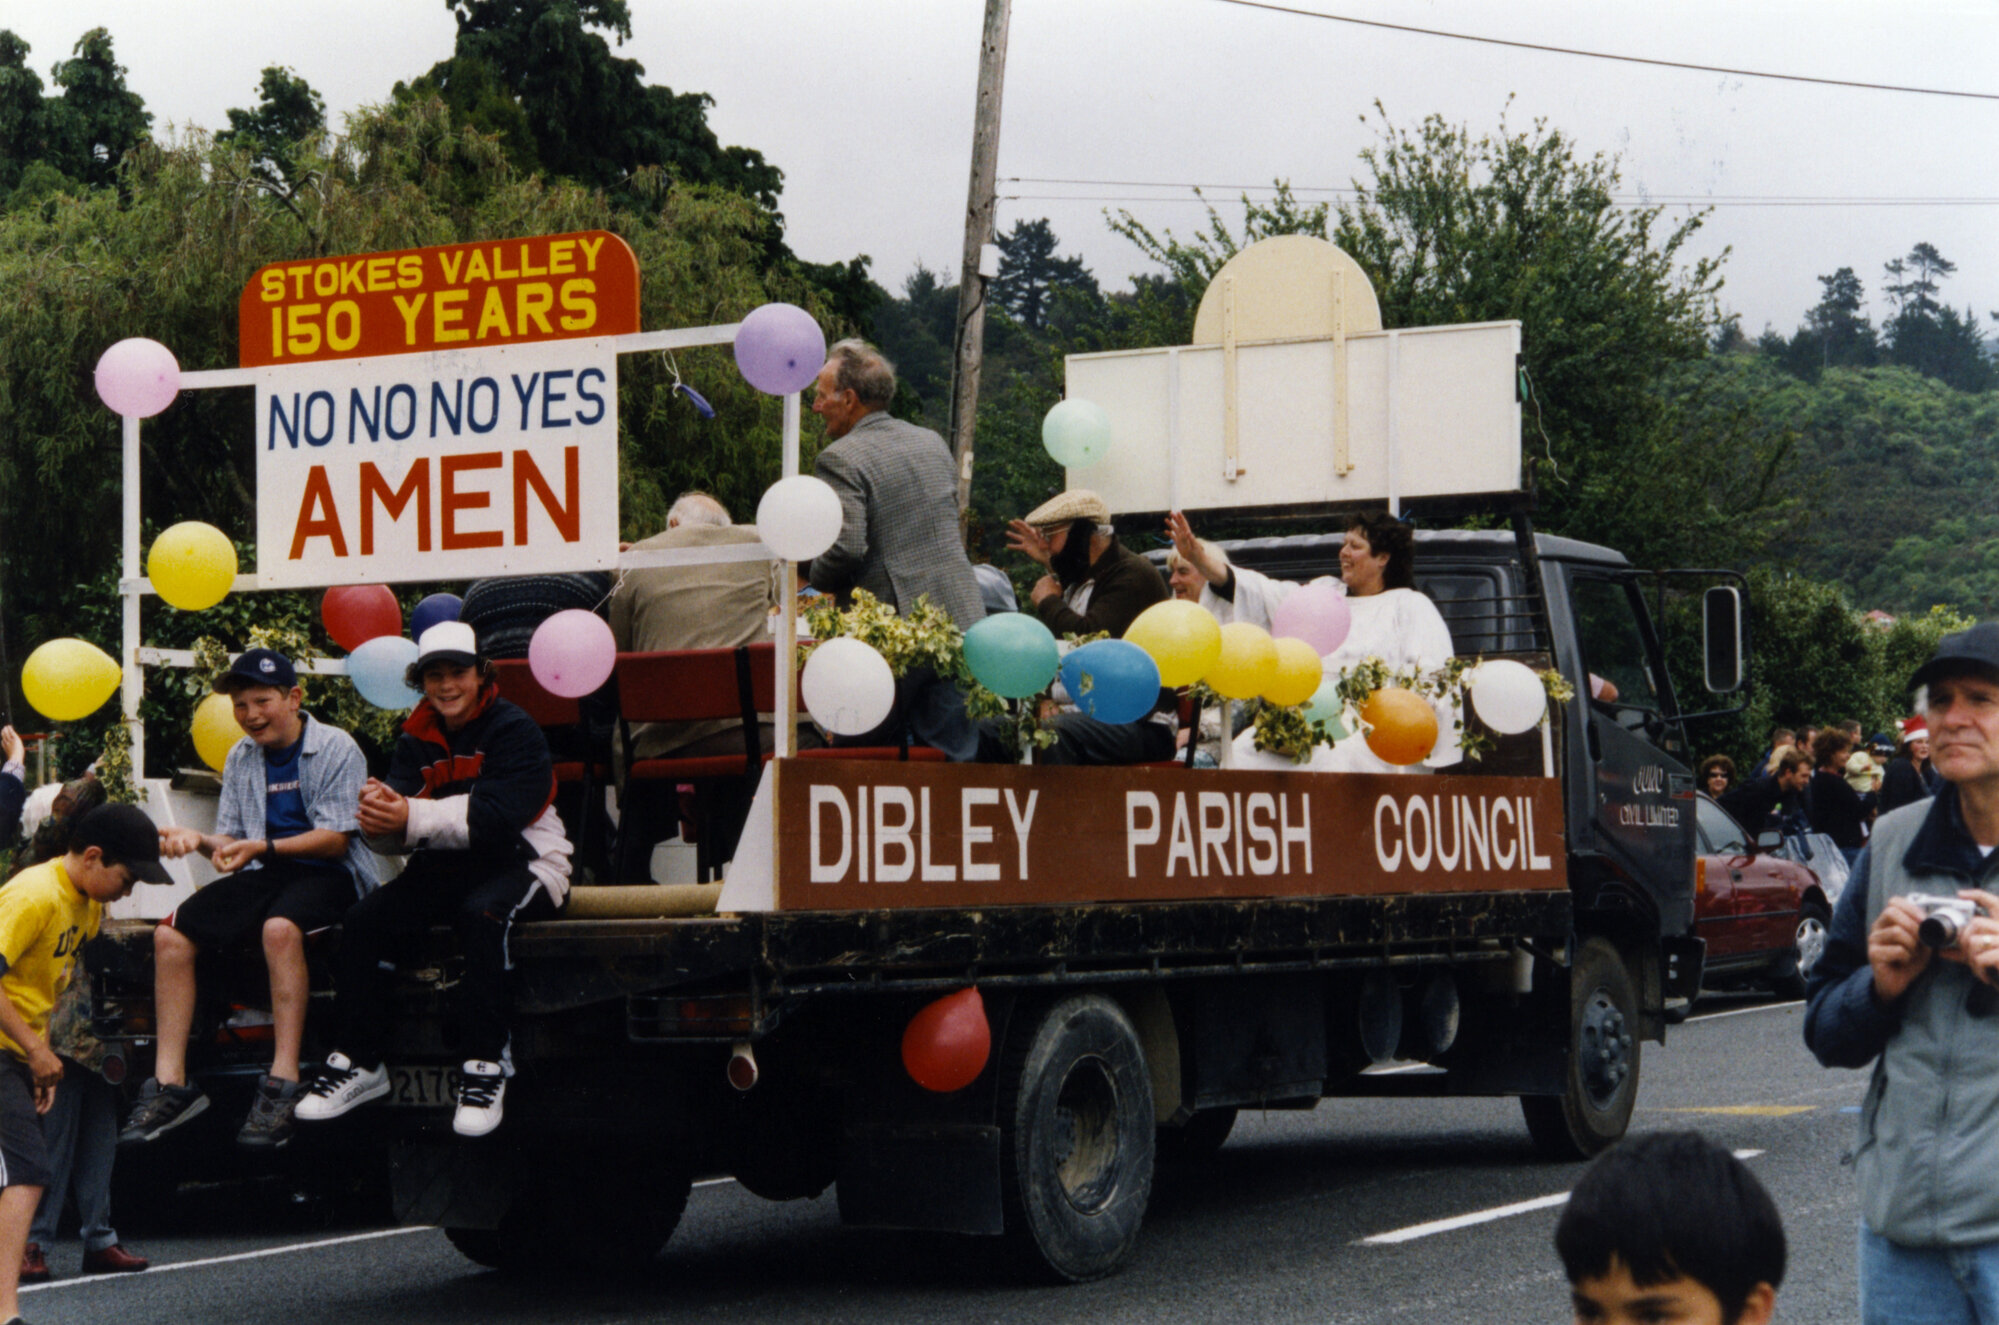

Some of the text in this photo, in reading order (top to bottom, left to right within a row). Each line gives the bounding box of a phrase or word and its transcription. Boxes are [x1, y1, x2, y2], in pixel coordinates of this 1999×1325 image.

[261, 237, 605, 302] STOKES VALLEY
[272, 278, 598, 358] 150 YEARS
[268, 368, 606, 450] NO NO NO YES
[288, 446, 580, 560] AMEN
[809, 784, 1552, 883] DIBLEY PARISH COUNCIL
[1620, 803, 1680, 828] CIVIL LIMITED
